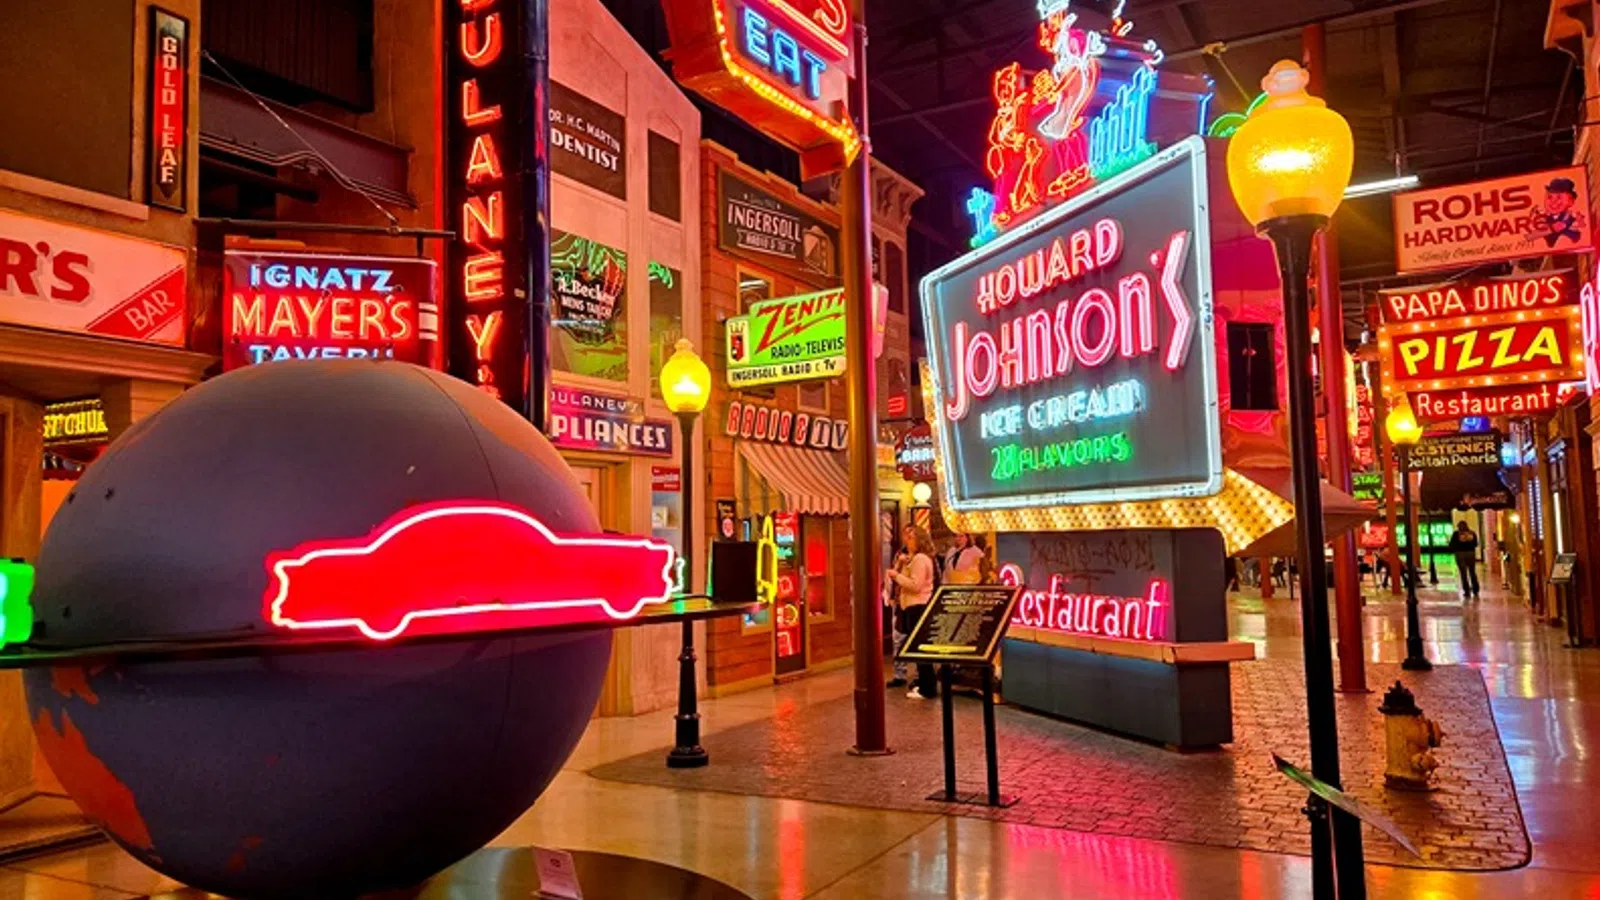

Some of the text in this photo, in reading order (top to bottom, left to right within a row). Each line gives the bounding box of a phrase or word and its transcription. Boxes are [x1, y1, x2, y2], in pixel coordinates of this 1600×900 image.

[744, 8, 826, 98] EAT
[159, 36, 178, 184] GOLD LEAF
[550, 127, 618, 172] DENTIST
[586, 122, 620, 153] MARTIN
[461, 0, 503, 400] ULANEY'
[1413, 185, 1532, 224] ROHS
[728, 203, 801, 242] INGERSOLL
[1403, 215, 1547, 249] HARDWARE
[249, 263, 394, 292] IGNATZ
[976, 217, 1124, 314] HOWARD
[124, 288, 176, 333] BAR
[230, 294, 412, 340] MAYER'S
[1390, 276, 1563, 320] PAPA DINO'S
[248, 343, 394, 365] TAVER
[731, 366, 778, 382] INGERSOLL
[781, 362, 812, 376] RADIO
[1399, 326, 1563, 376] PIZZA
[980, 378, 1146, 439] ICE CREAM
[1416, 385, 1551, 417] Restaurant
[726, 401, 791, 443] RADIO
[810, 416, 848, 450] TV
[1019, 431, 1134, 472] FLAVORS
[1452, 453, 1498, 465] Pearls
